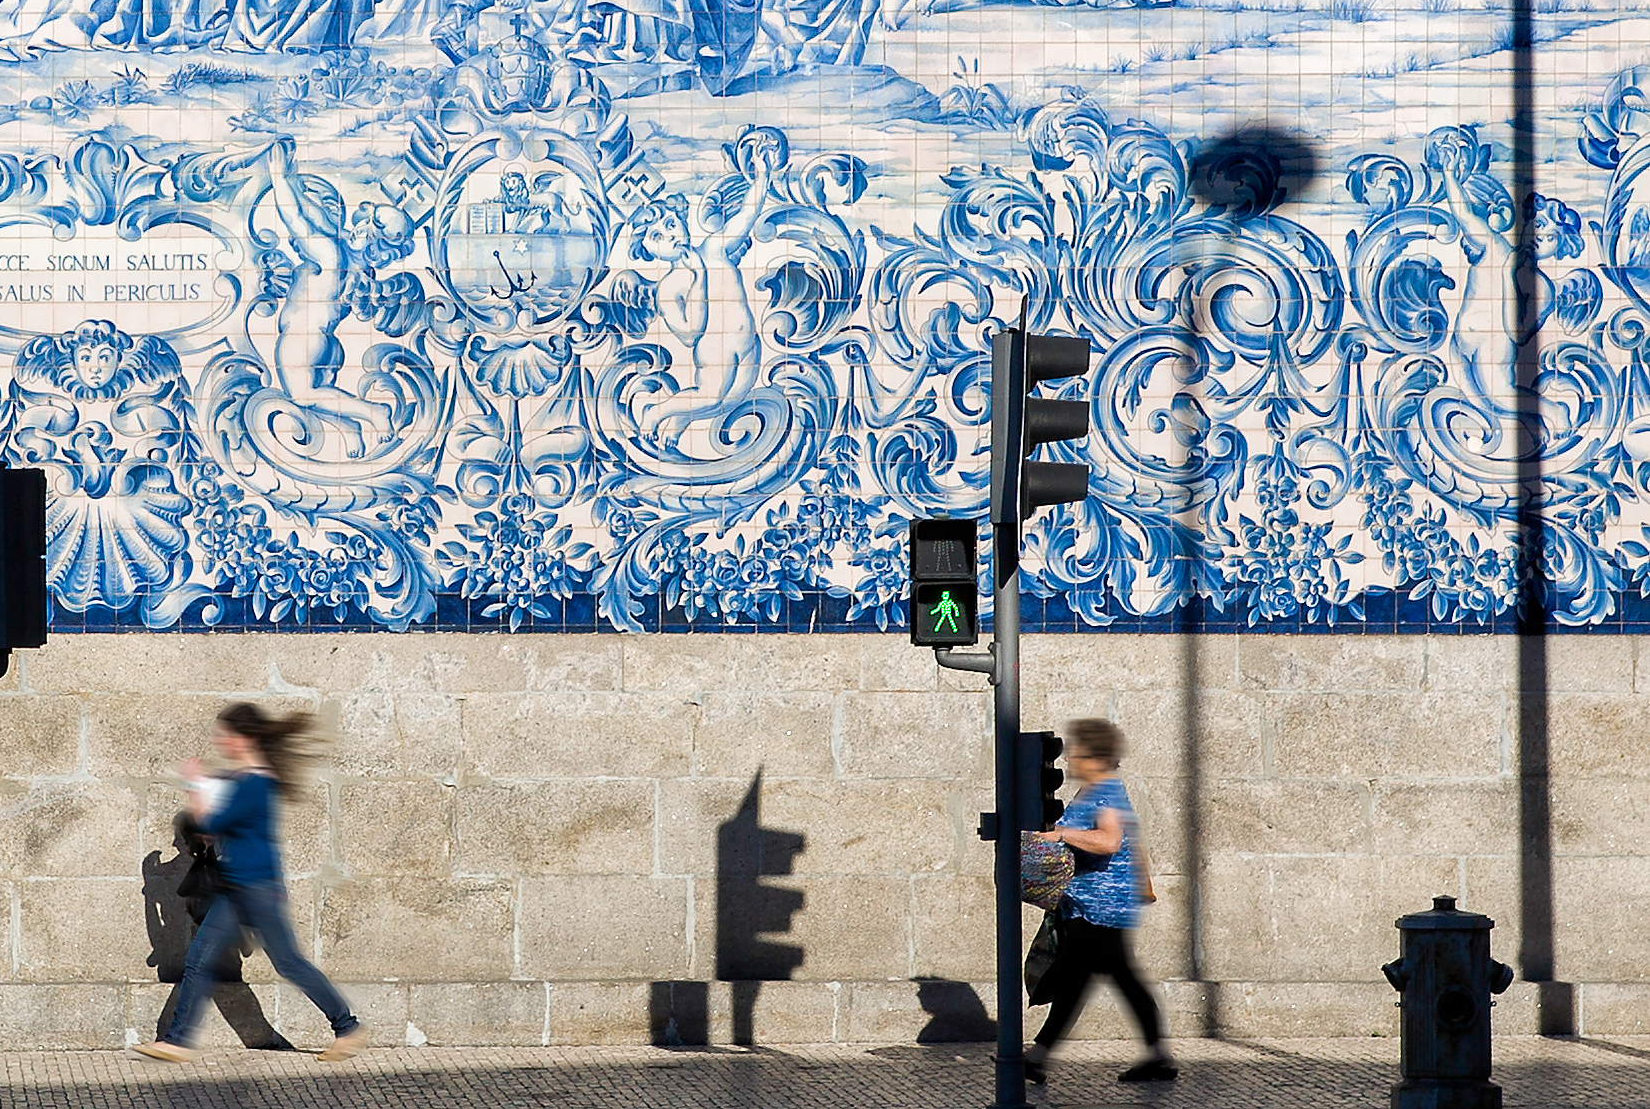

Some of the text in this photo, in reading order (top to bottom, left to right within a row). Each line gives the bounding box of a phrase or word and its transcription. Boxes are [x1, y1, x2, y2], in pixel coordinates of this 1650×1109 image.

[46, 254, 110, 271] SIGNUM
[126, 253, 208, 271] SALUTIS
[67, 284, 84, 301] IN
[104, 283, 201, 301] PERICULIS
